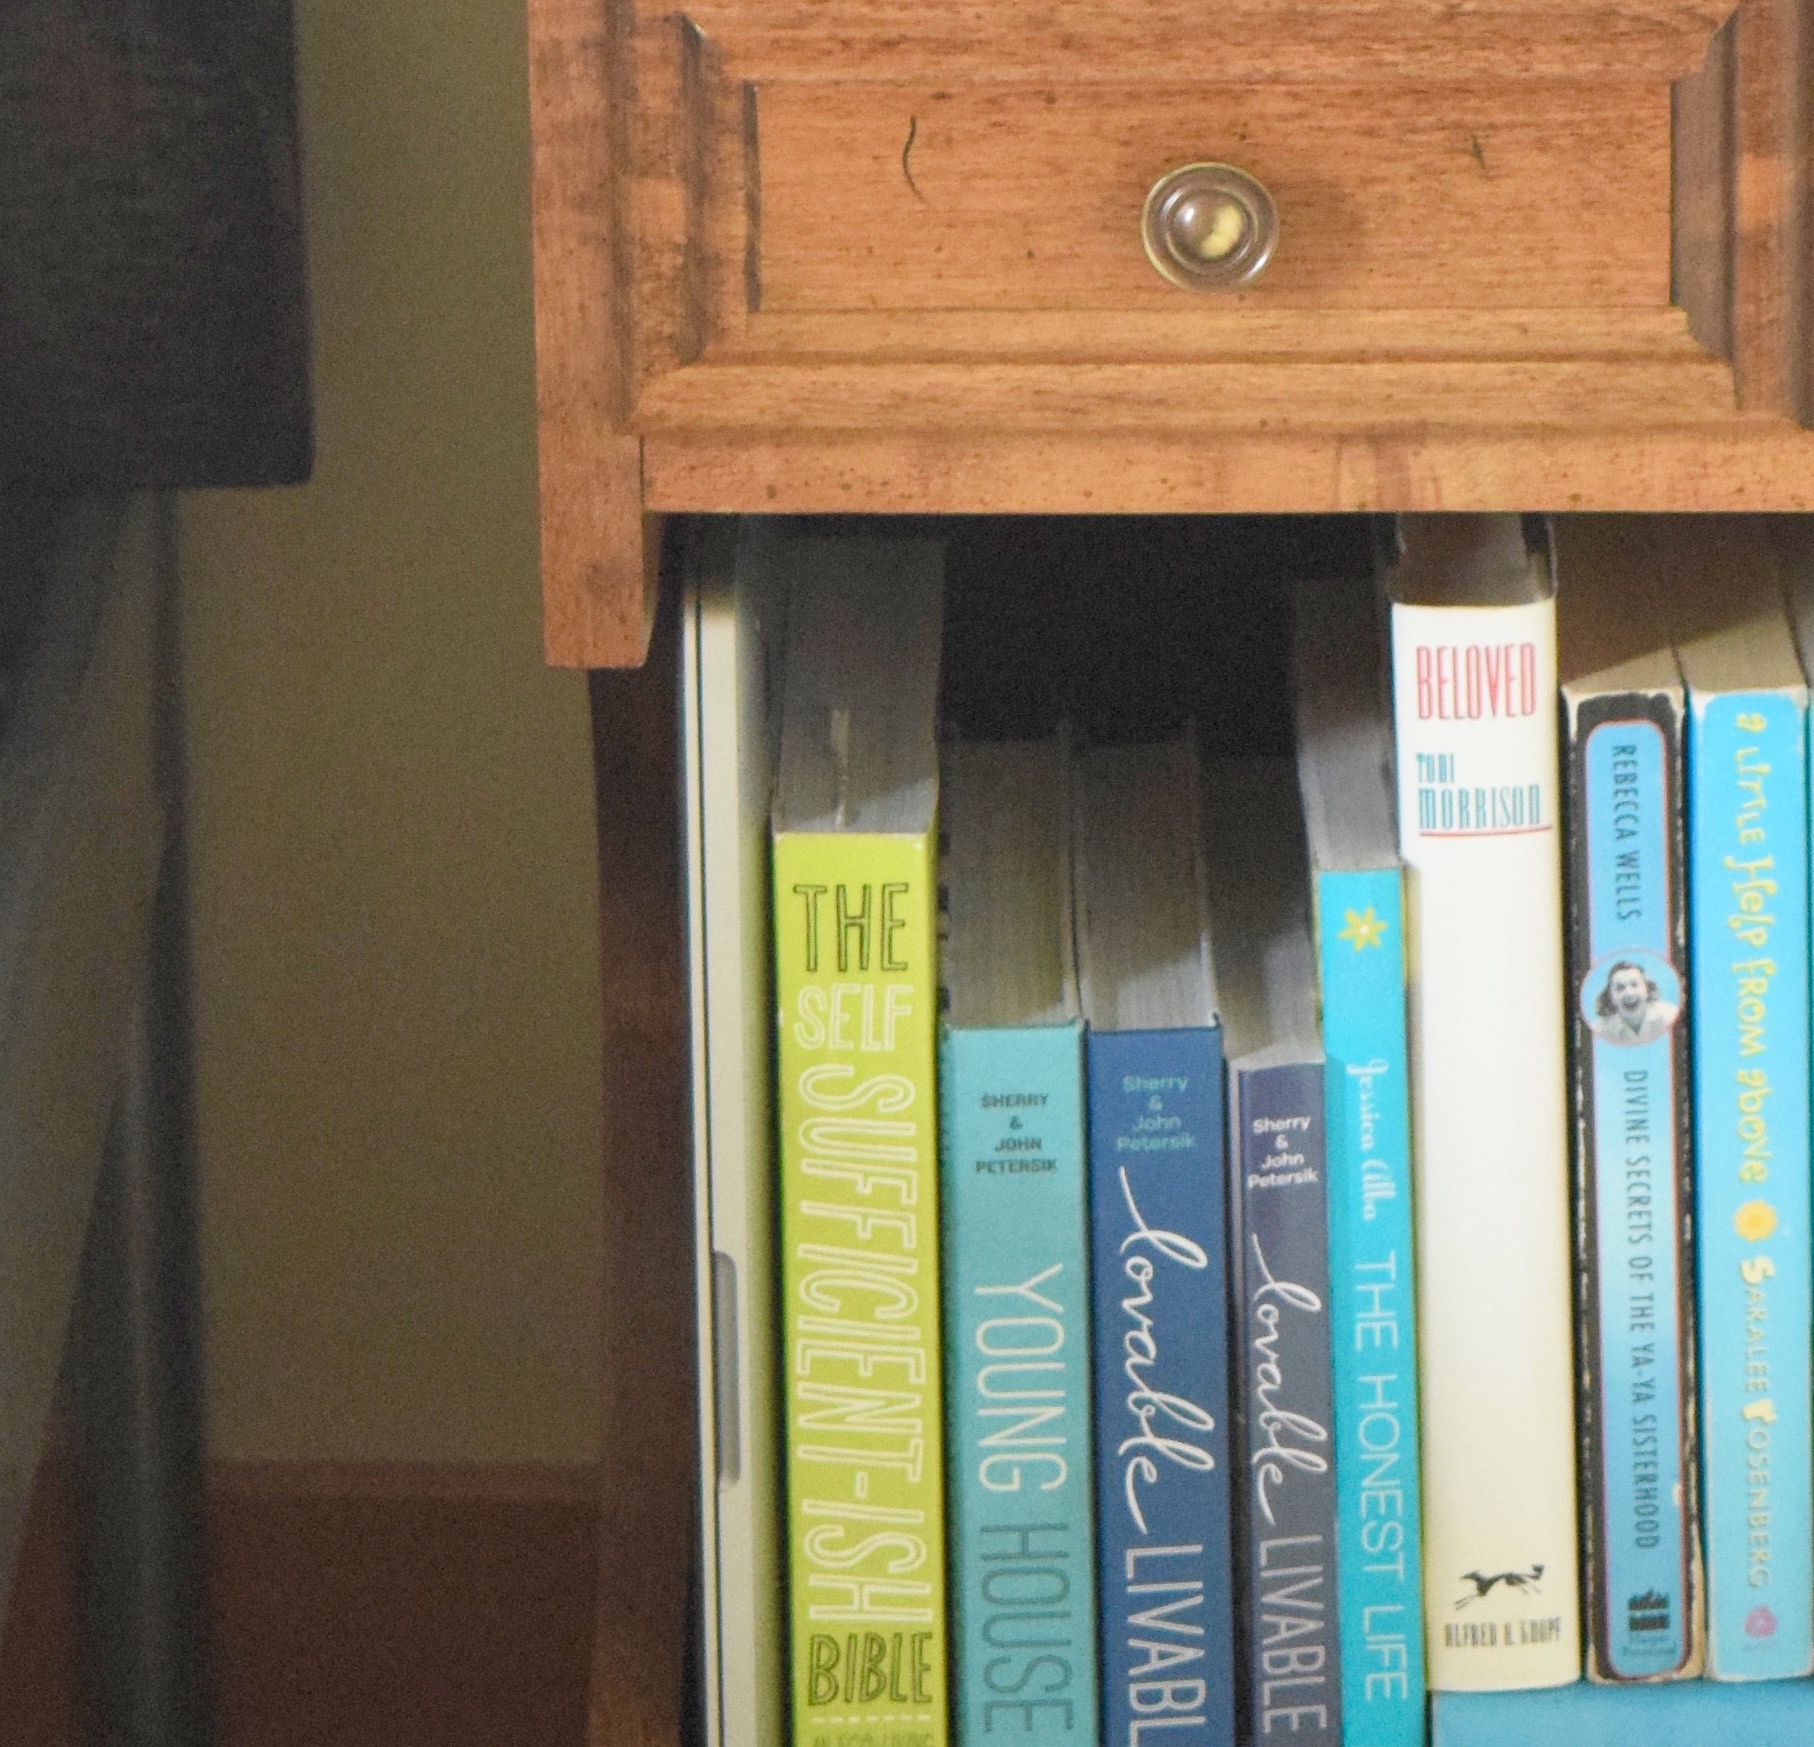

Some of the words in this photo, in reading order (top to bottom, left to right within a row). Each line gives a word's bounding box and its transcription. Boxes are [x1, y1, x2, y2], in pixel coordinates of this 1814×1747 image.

[1415, 640, 1538, 721] BELOVED
[1417, 783, 1542, 831] MORRISON
[1611, 743, 1639, 842] REBECCA
[1614, 850, 1642, 923] WELLS
[793, 882, 909, 972] THE
[794, 983, 914, 1051] SELF
[981, 1092, 1049, 1109] SHERRY
[1122, 1075, 1189, 1093] Sherry
[1149, 1095, 1163, 1111] &
[1346, 1057, 1390, 1152] Jessica
[1623, 1069, 1651, 1146] DIVINE
[995, 1136, 1042, 1153] JOHN
[1009, 1115, 1023, 1130] &
[1117, 1134, 1196, 1152] Petersik
[1132, 1114, 1182, 1133] John
[1253, 1115, 1312, 1134] Sherry
[1275, 1134, 1289, 1149] &
[976, 1157, 1057, 1174] PETERSIK
[1247, 1167, 1320, 1189] Petersik
[1260, 1152, 1306, 1170] John
[1625, 1155, 1654, 1246] SECRETS
[1353, 1248, 1401, 1354] THE
[1628, 1256, 1655, 1282] OF
[793, 1063, 934, 1623] SUFFICIENT-ISH
[1629, 1292, 1656, 1333] THE
[975, 1263, 1068, 1492] YOUNG
[1118, 1165, 1216, 1535] lovable
[1250, 1232, 1329, 1527] lovable
[1630, 1342, 1657, 1405] YA-YA
[1357, 1373, 1406, 1583] HONEST
[1631, 1410, 1661, 1551] SISTERHOOD
[979, 1522, 1073, 1734] HOUSE
[1257, 1532, 1329, 1735] LIVABLE
[1361, 1604, 1410, 1702] LIFE
[808, 1631, 932, 1707] BIBLE
